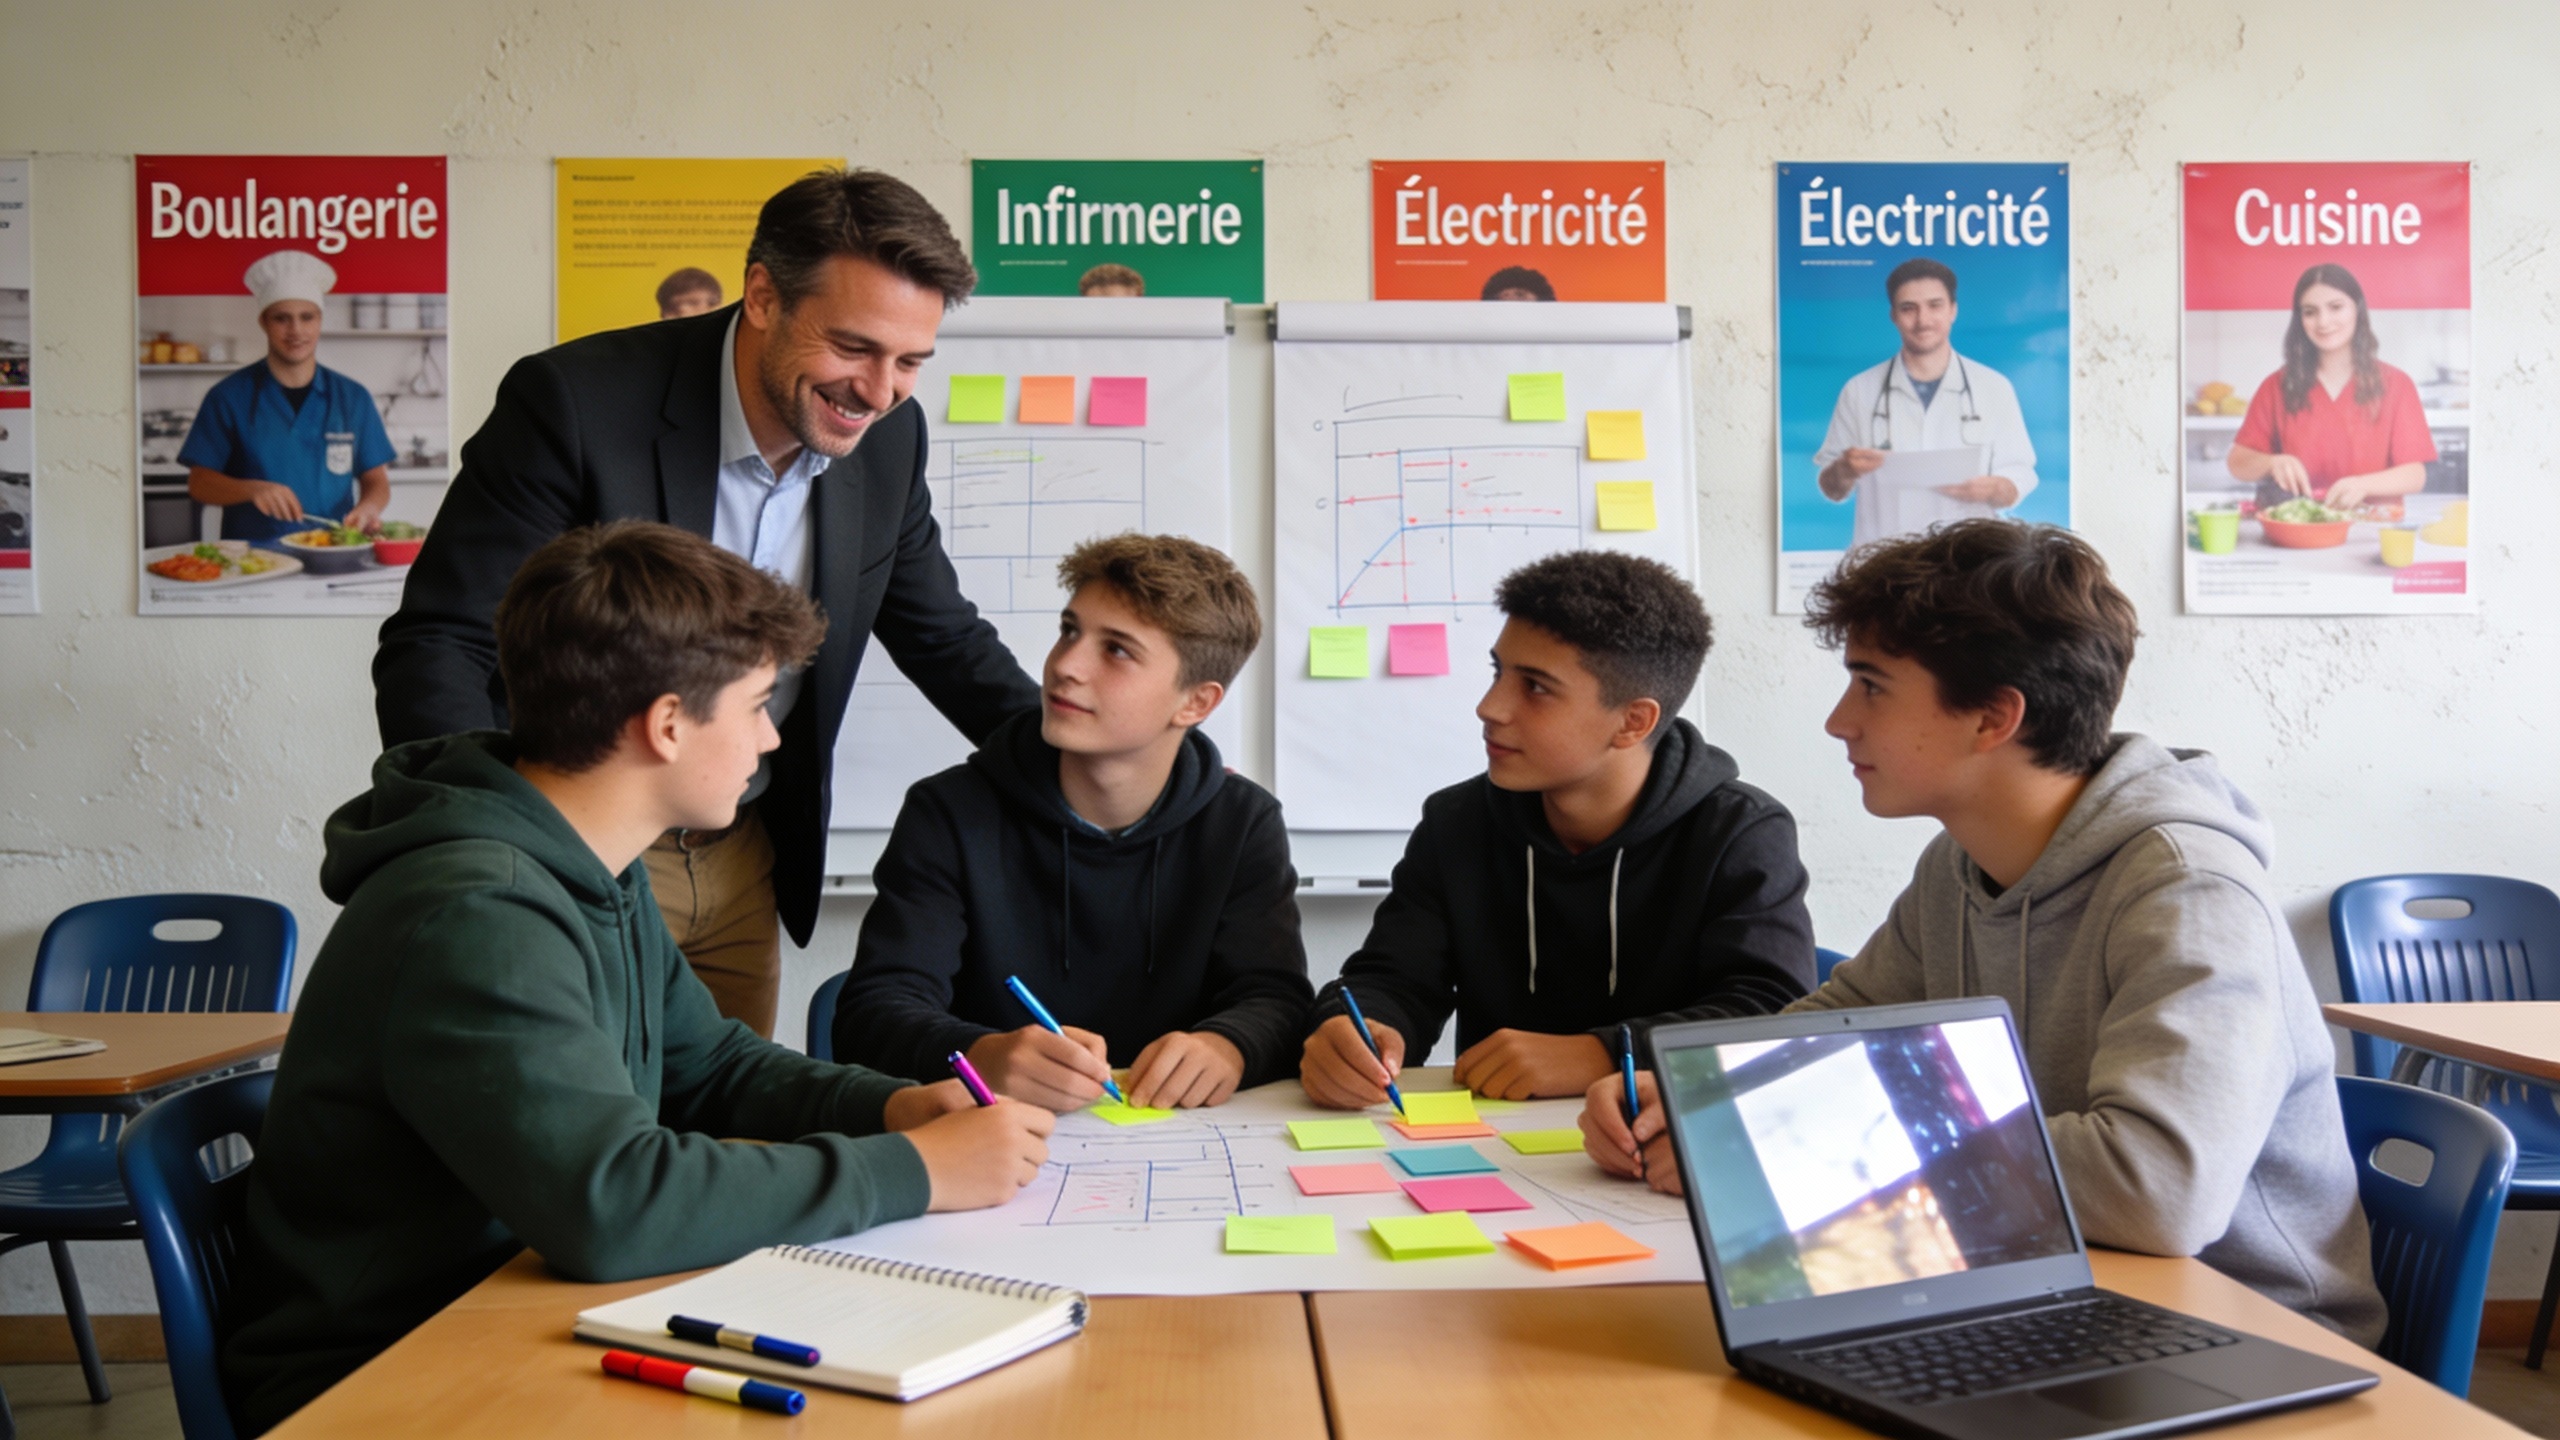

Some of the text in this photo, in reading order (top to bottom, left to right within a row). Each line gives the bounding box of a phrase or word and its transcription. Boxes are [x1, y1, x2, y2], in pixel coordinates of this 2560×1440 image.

[150, 178, 438, 255] Boulangerie
[997, 185, 1243, 246] Infirmerie
[1395, 174, 1648, 247] Électricité
[1799, 176, 2051, 248] Électricité
[2234, 187, 2422, 247] Cuisine
